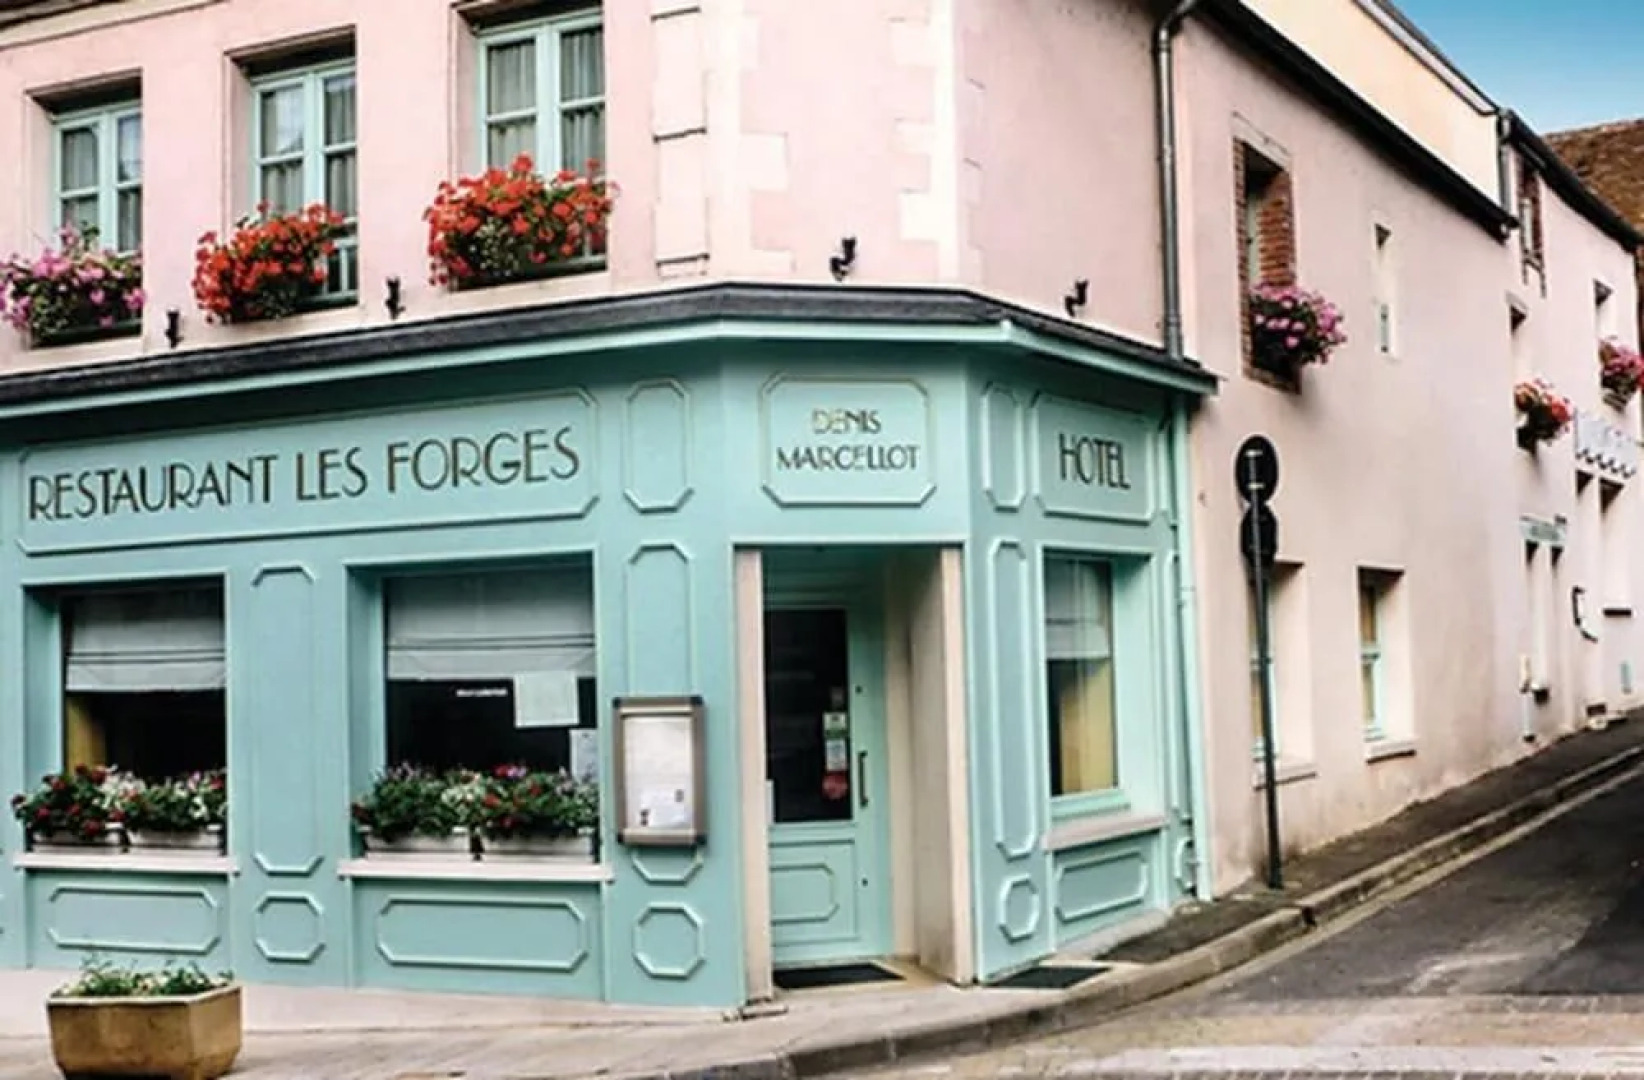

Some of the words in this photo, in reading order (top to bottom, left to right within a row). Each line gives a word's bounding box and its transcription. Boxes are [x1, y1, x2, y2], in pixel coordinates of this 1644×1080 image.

[812, 408, 882, 435] DENIS
[29, 454, 278, 520] RESTAURANT
[296, 447, 368, 501] LES
[387, 426, 580, 493] FORGES
[776, 445, 921, 471] MARCELLOT
[1059, 432, 1131, 490] HOTEL
